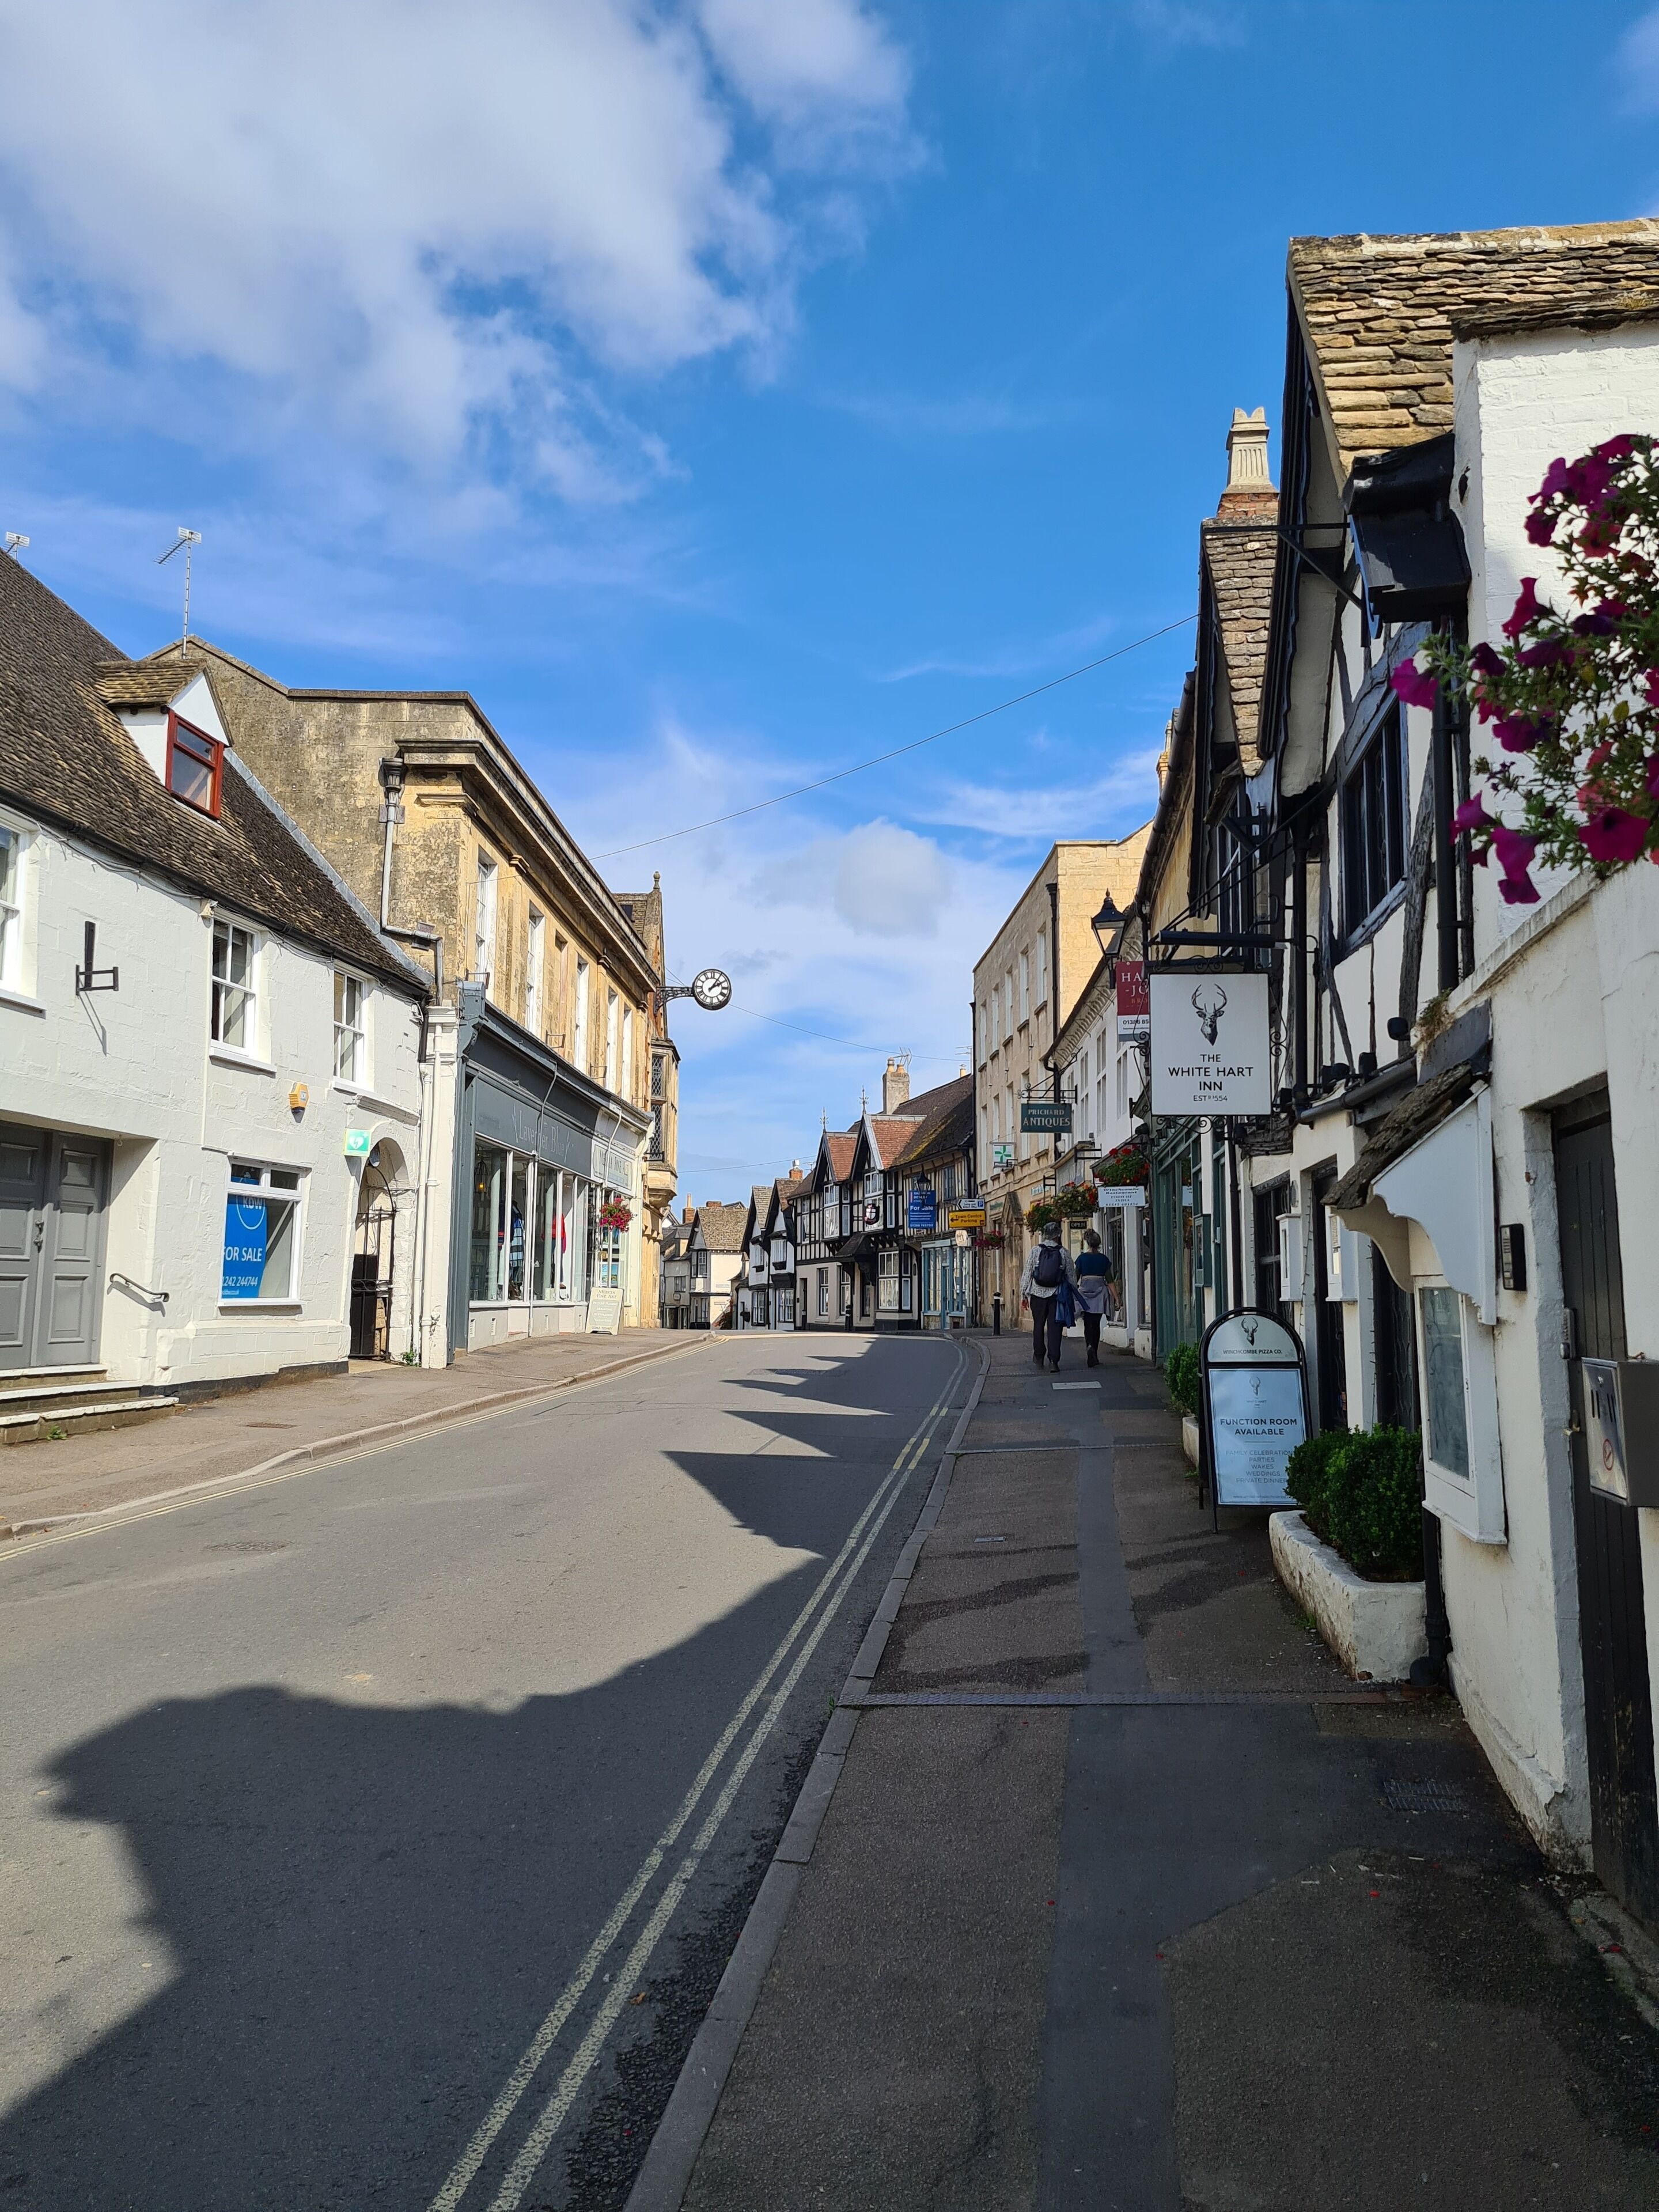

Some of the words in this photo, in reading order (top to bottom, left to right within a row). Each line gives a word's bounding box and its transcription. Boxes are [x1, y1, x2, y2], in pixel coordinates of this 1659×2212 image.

[1121, 972, 1143, 982] HA
[1125, 985, 1148, 997] -JO
[1200, 1054, 1221, 1062] THE
[1168, 1067, 1211, 1077] WHITE
[1217, 1067, 1253, 1077] HART
[1199, 1081, 1222, 1091] INN
[1023, 1118, 1070, 1127] ANTIQUES
[243, 1196, 262, 1210] KDW
[241, 1247, 263, 1262] SALE
[222, 1276, 236, 1286] 1242
[237, 1276, 258, 1286] 244744
